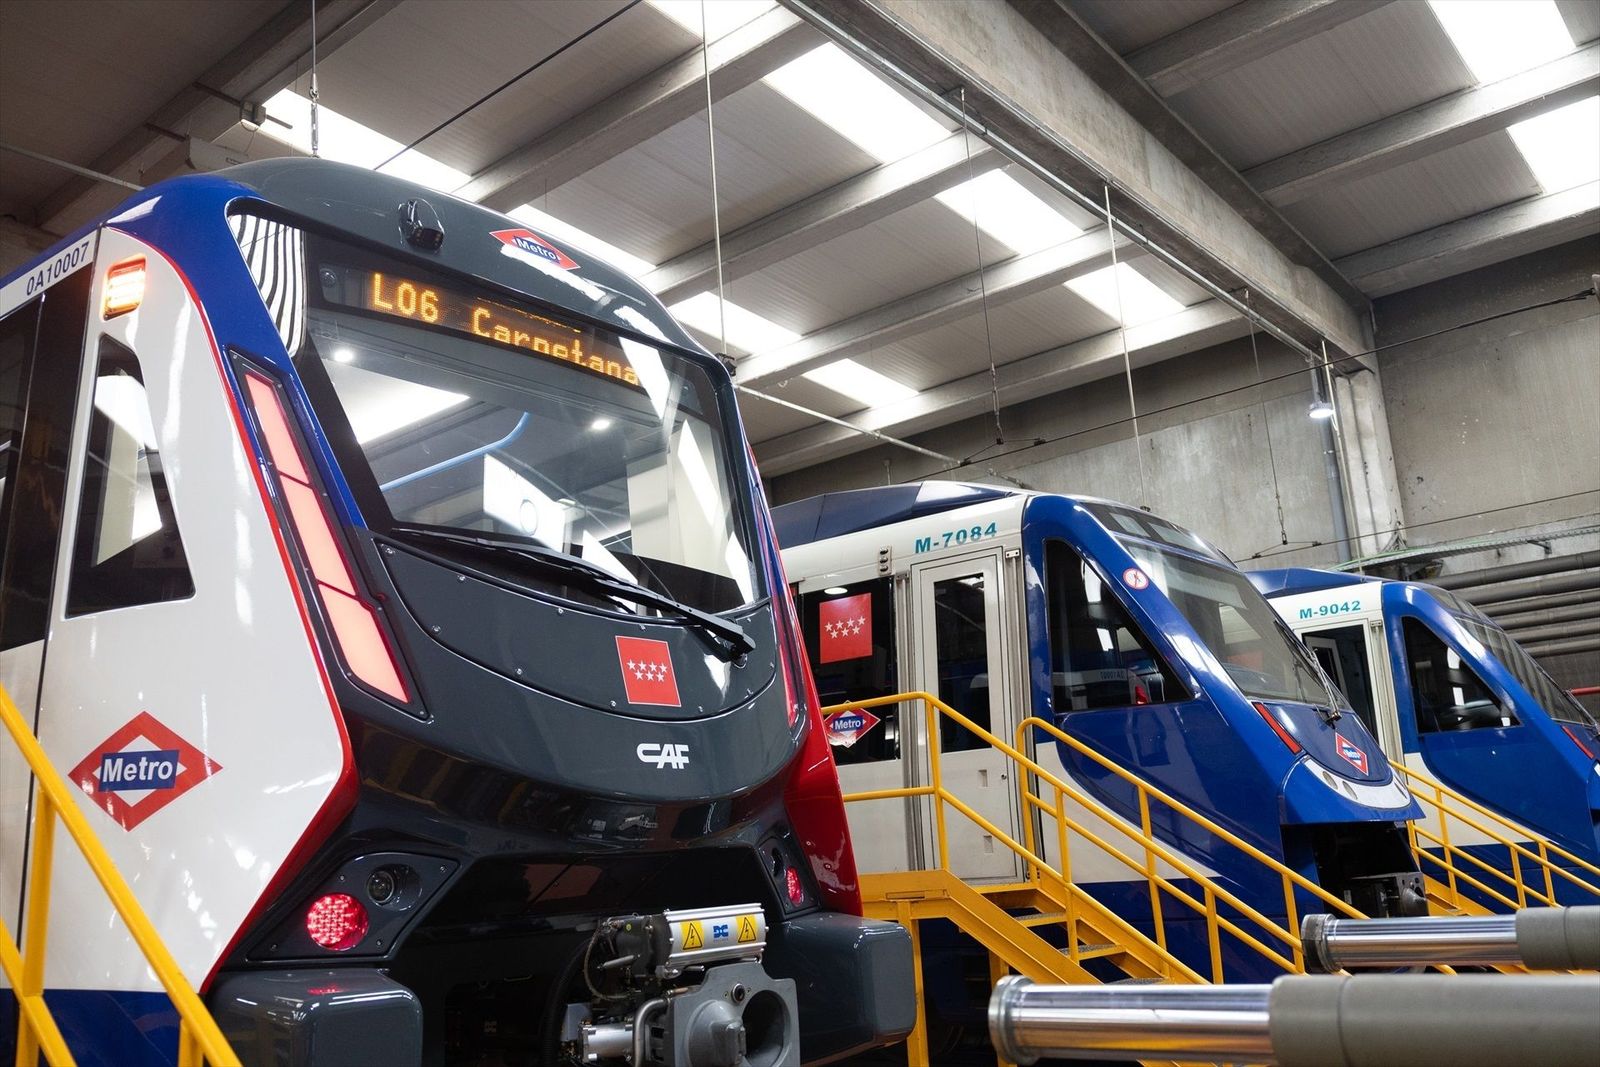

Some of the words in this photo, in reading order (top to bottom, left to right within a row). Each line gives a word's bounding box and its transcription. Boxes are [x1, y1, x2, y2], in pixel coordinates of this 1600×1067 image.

[516, 238, 557, 260] Metro
[26, 241, 90, 296] 0A10007
[373, 273, 439, 323] L06
[915, 522, 997, 554] M-7084
[1299, 600, 1361, 619] M-9042
[834, 721, 861, 730] Metro
[636, 743, 690, 769] CAF
[102, 756, 174, 783] Metro
